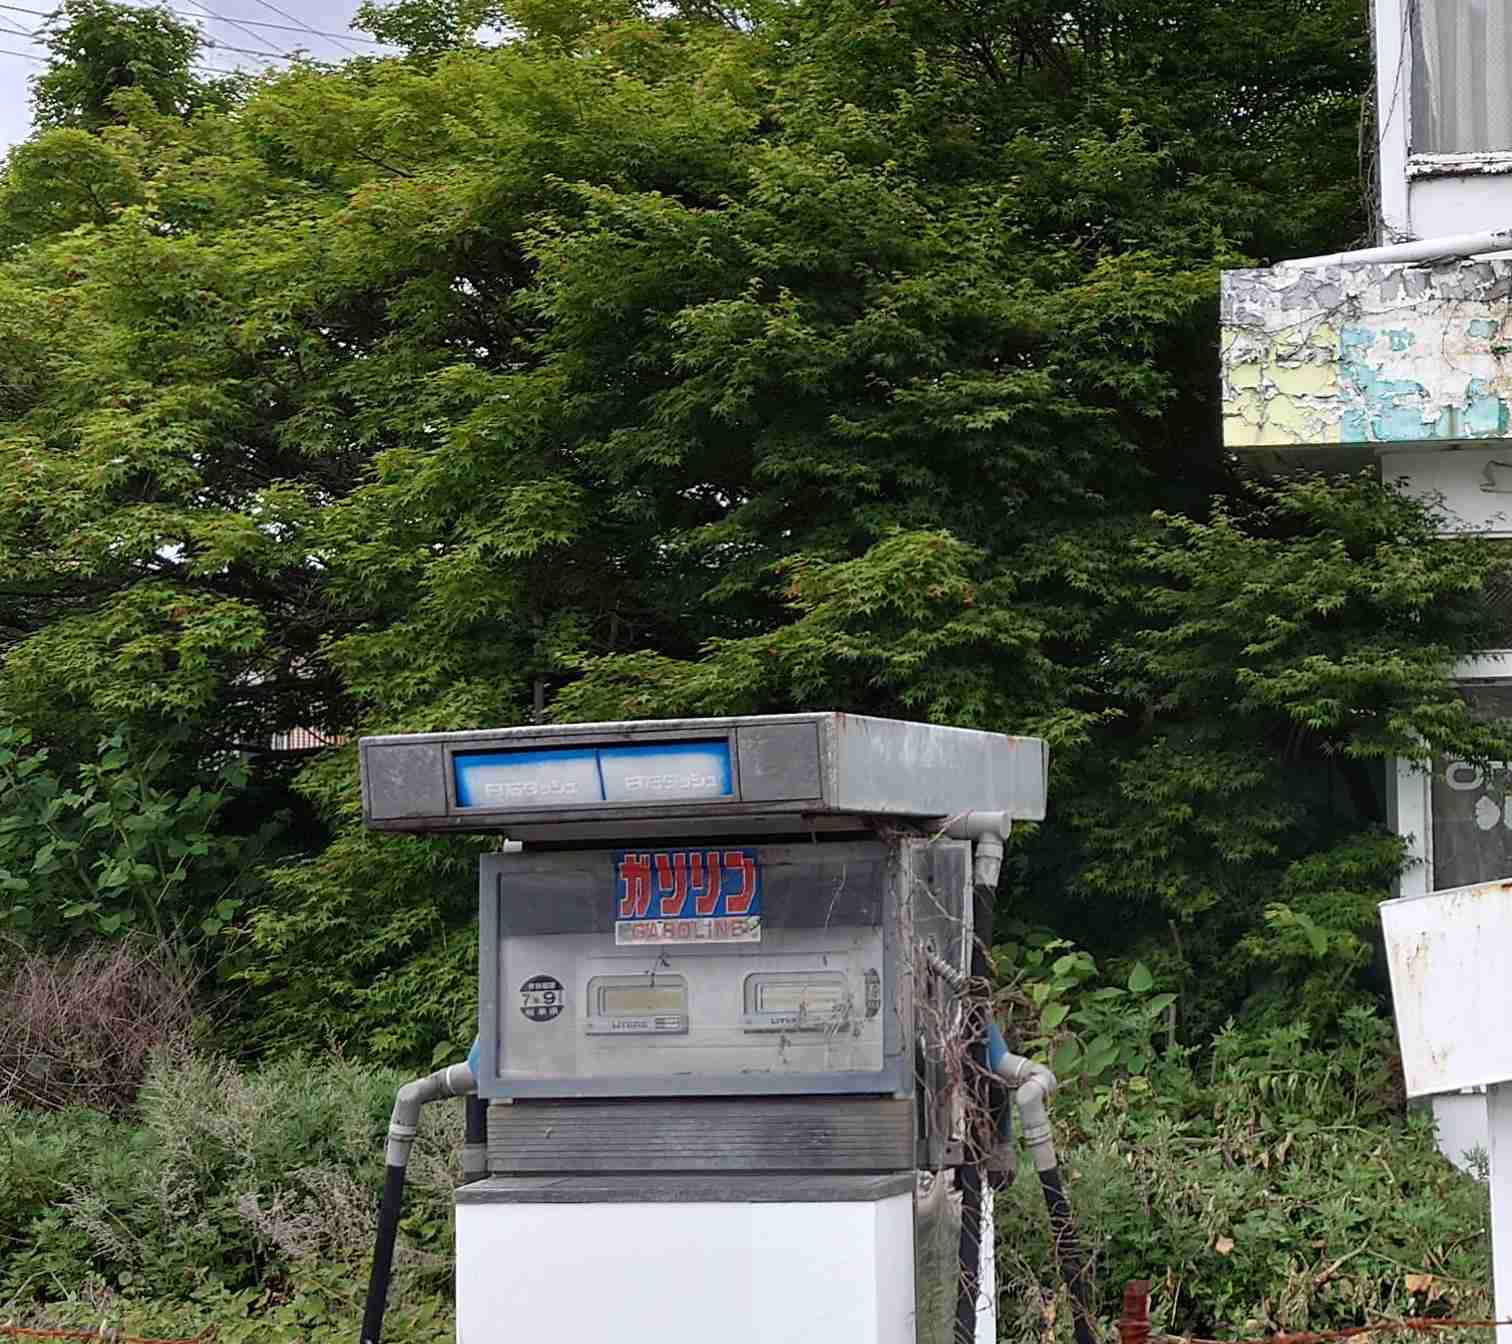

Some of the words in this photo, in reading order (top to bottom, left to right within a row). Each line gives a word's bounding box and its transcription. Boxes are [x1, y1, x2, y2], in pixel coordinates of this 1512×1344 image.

[618, 851, 756, 918] ガソリン
[631, 919, 750, 941] GASOLINE
